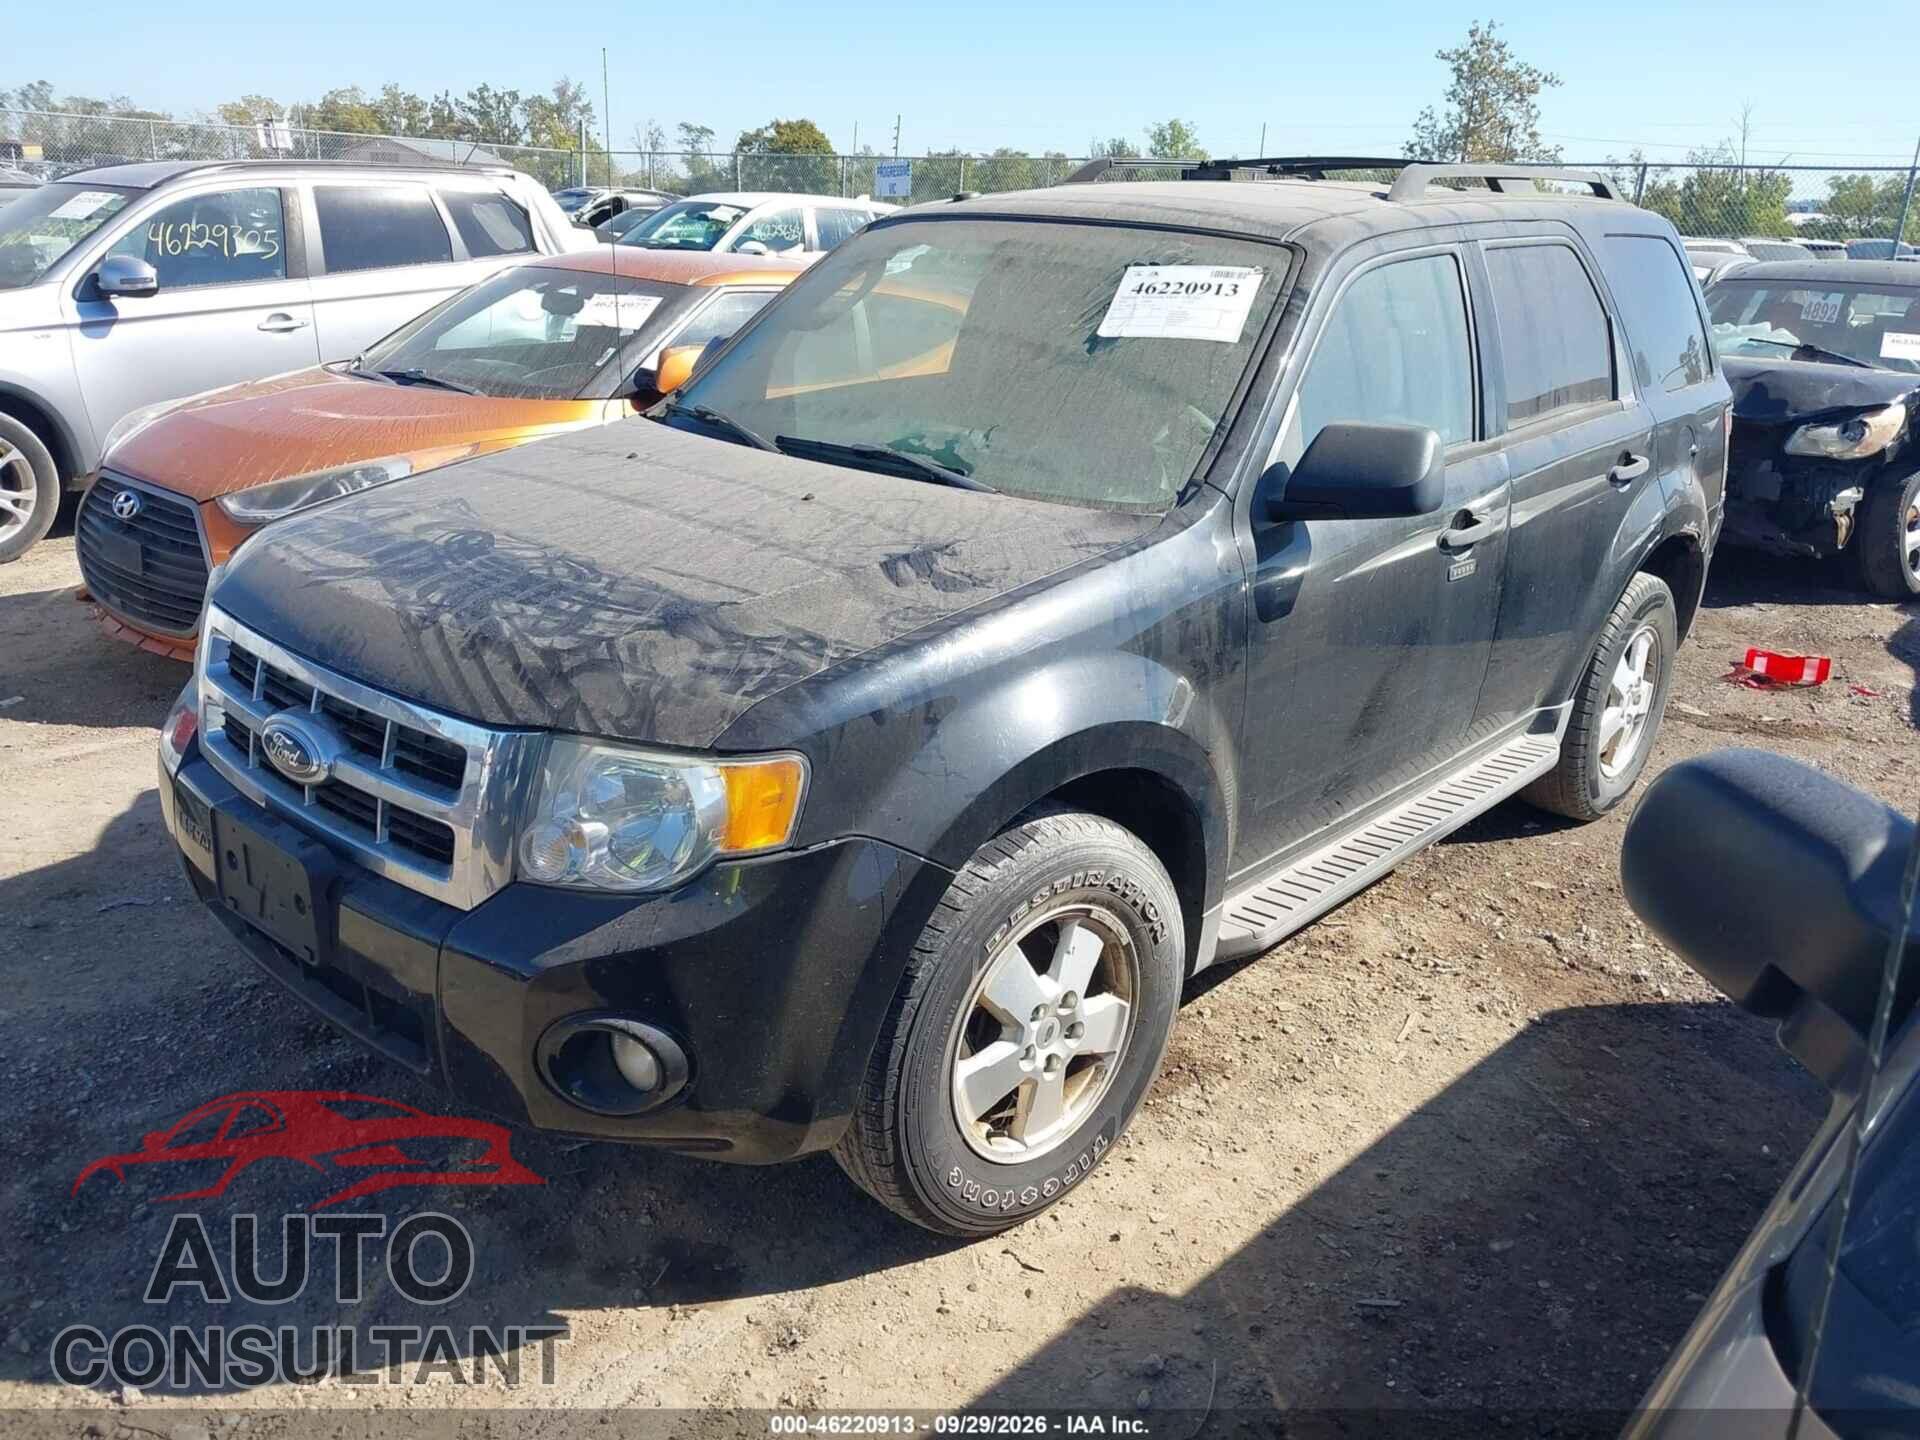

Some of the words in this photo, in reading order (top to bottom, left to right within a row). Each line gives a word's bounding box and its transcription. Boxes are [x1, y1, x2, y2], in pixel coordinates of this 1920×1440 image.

[147, 222, 280, 260] 46229305
[1130, 281, 1239, 297] 46220913
[269, 731, 301, 767] Ford
[984, 869, 1168, 954] DESTINATION
